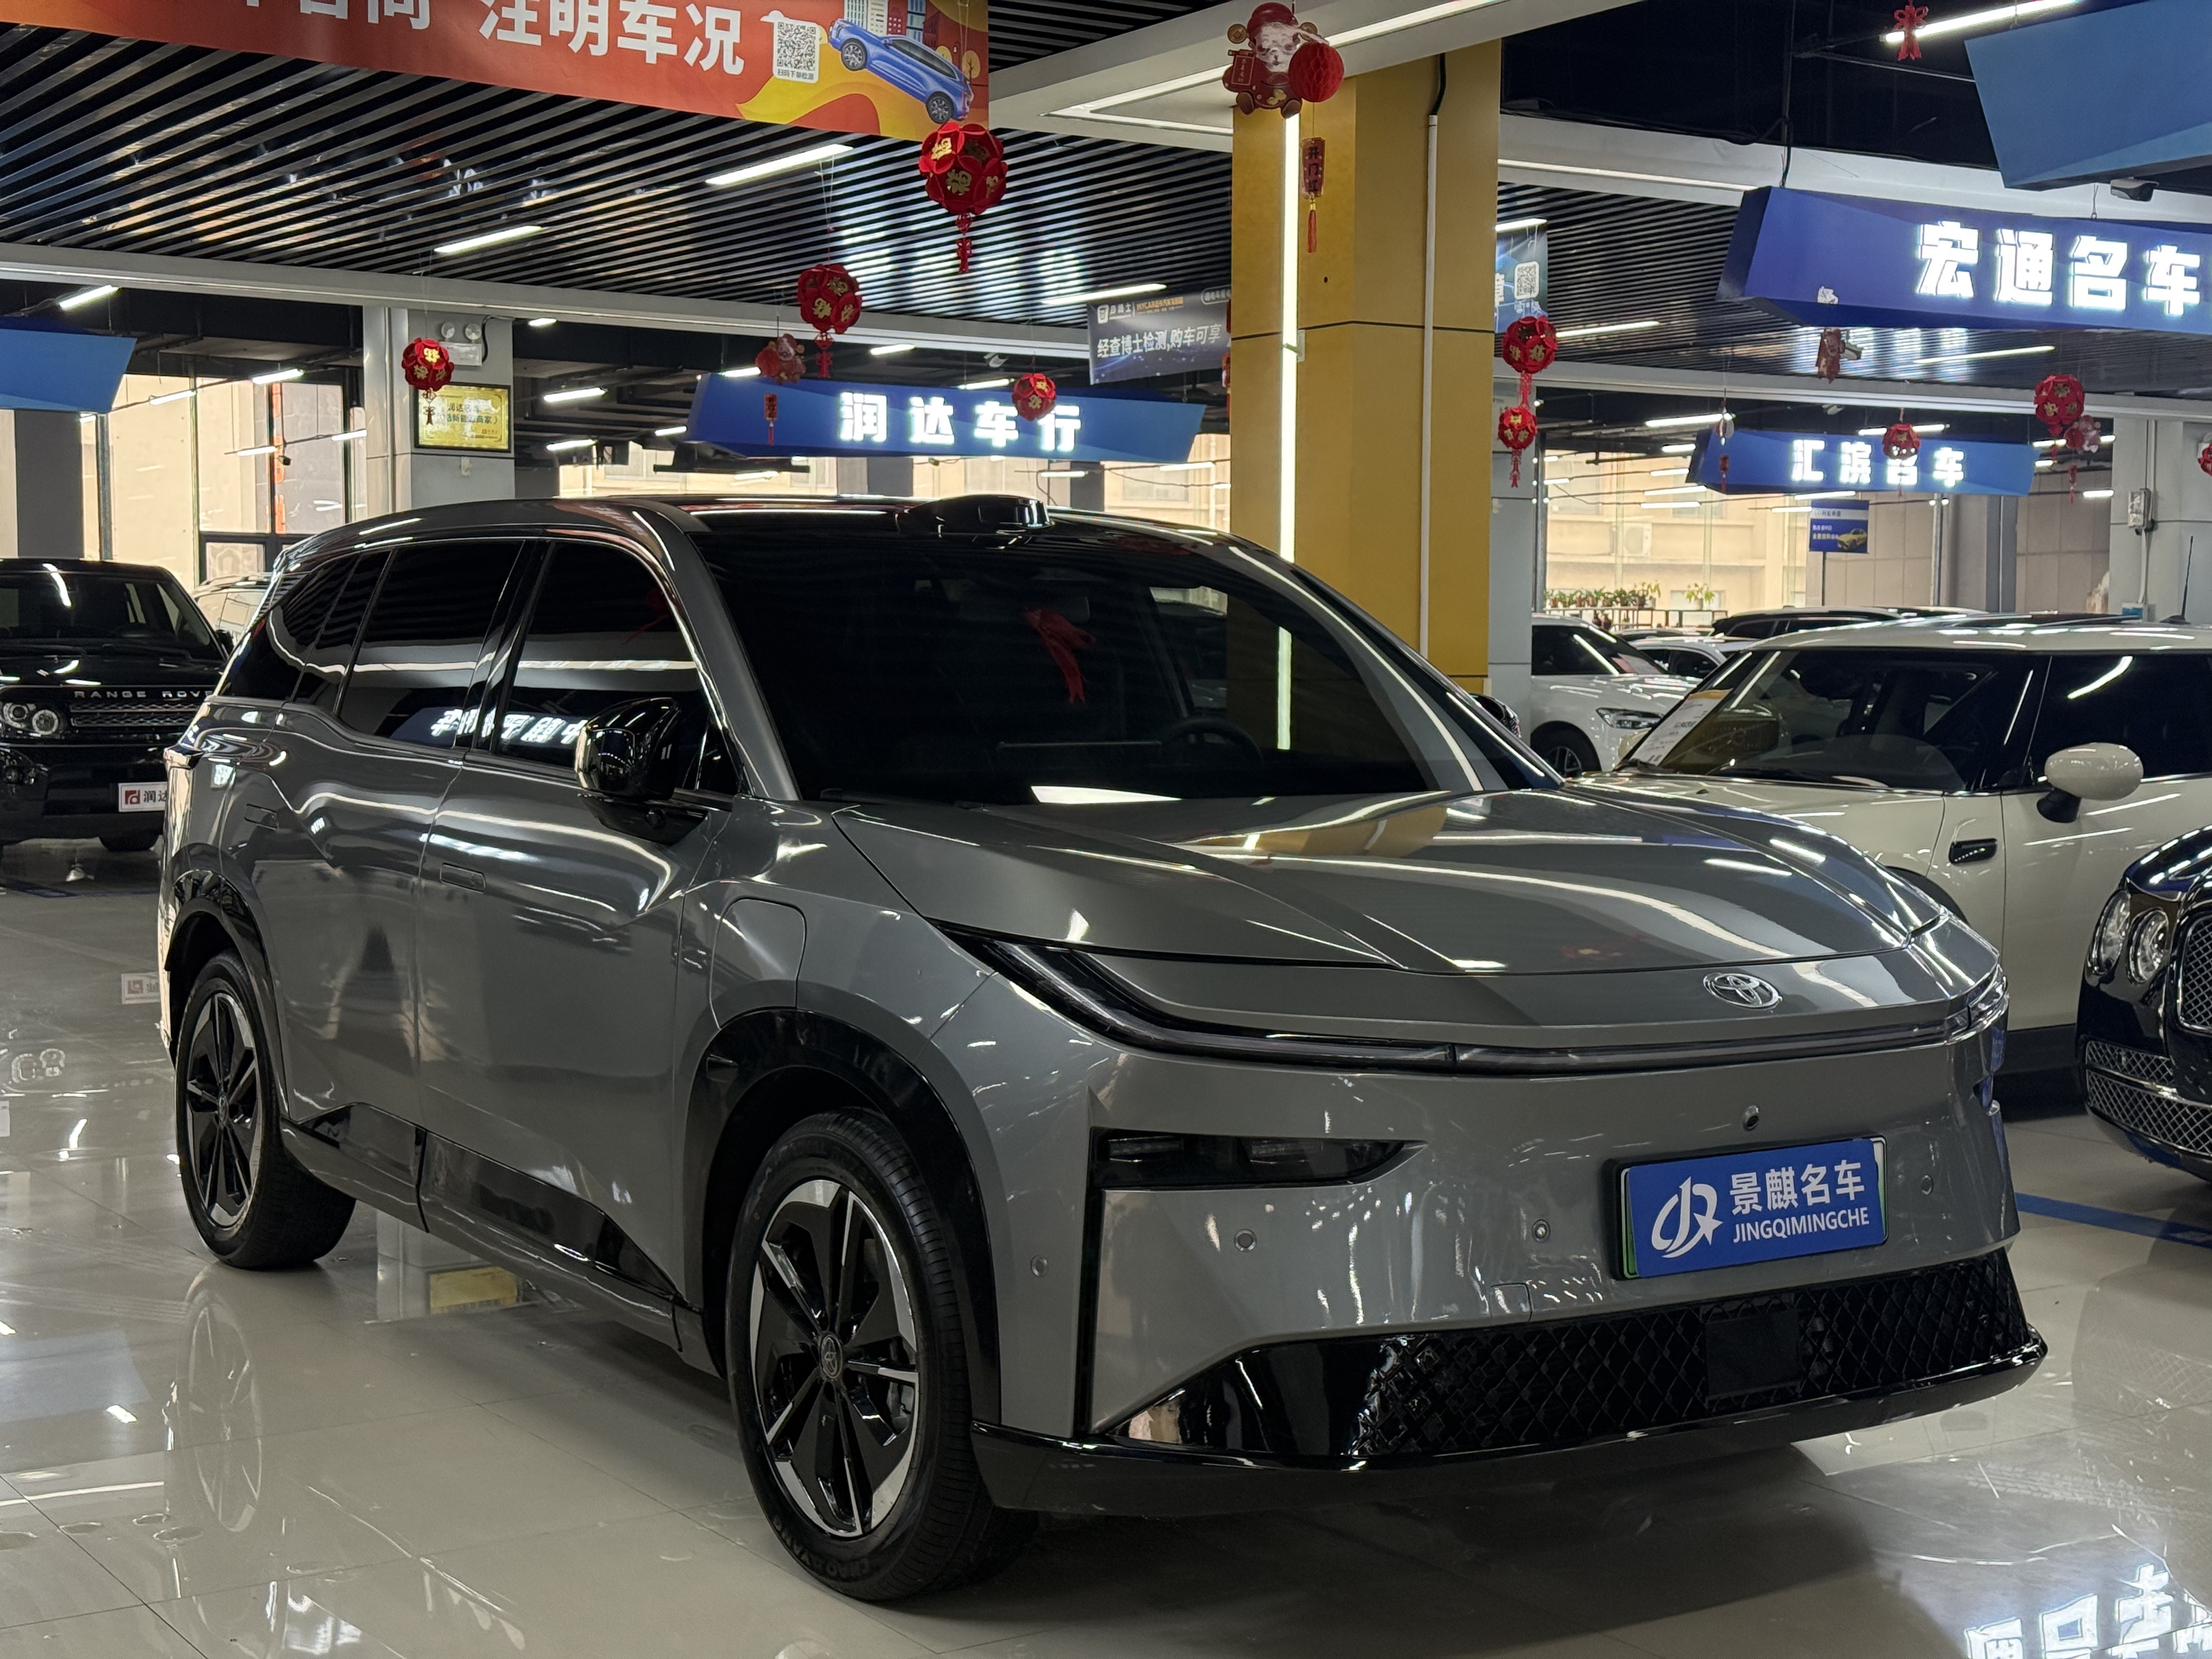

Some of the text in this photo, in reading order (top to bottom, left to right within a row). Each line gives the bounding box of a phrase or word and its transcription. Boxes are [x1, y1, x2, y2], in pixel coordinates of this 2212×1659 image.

[478, 0, 744, 75] 注明车况
[1915, 221, 2200, 316] 宏通名车
[839, 392, 1081, 451] 润达车行
[1791, 439, 1964, 487] 汇滨名车
[1730, 1159, 1865, 1216] 景麒名车
[1733, 1206, 1870, 1244] JINGQIMINGCHE
